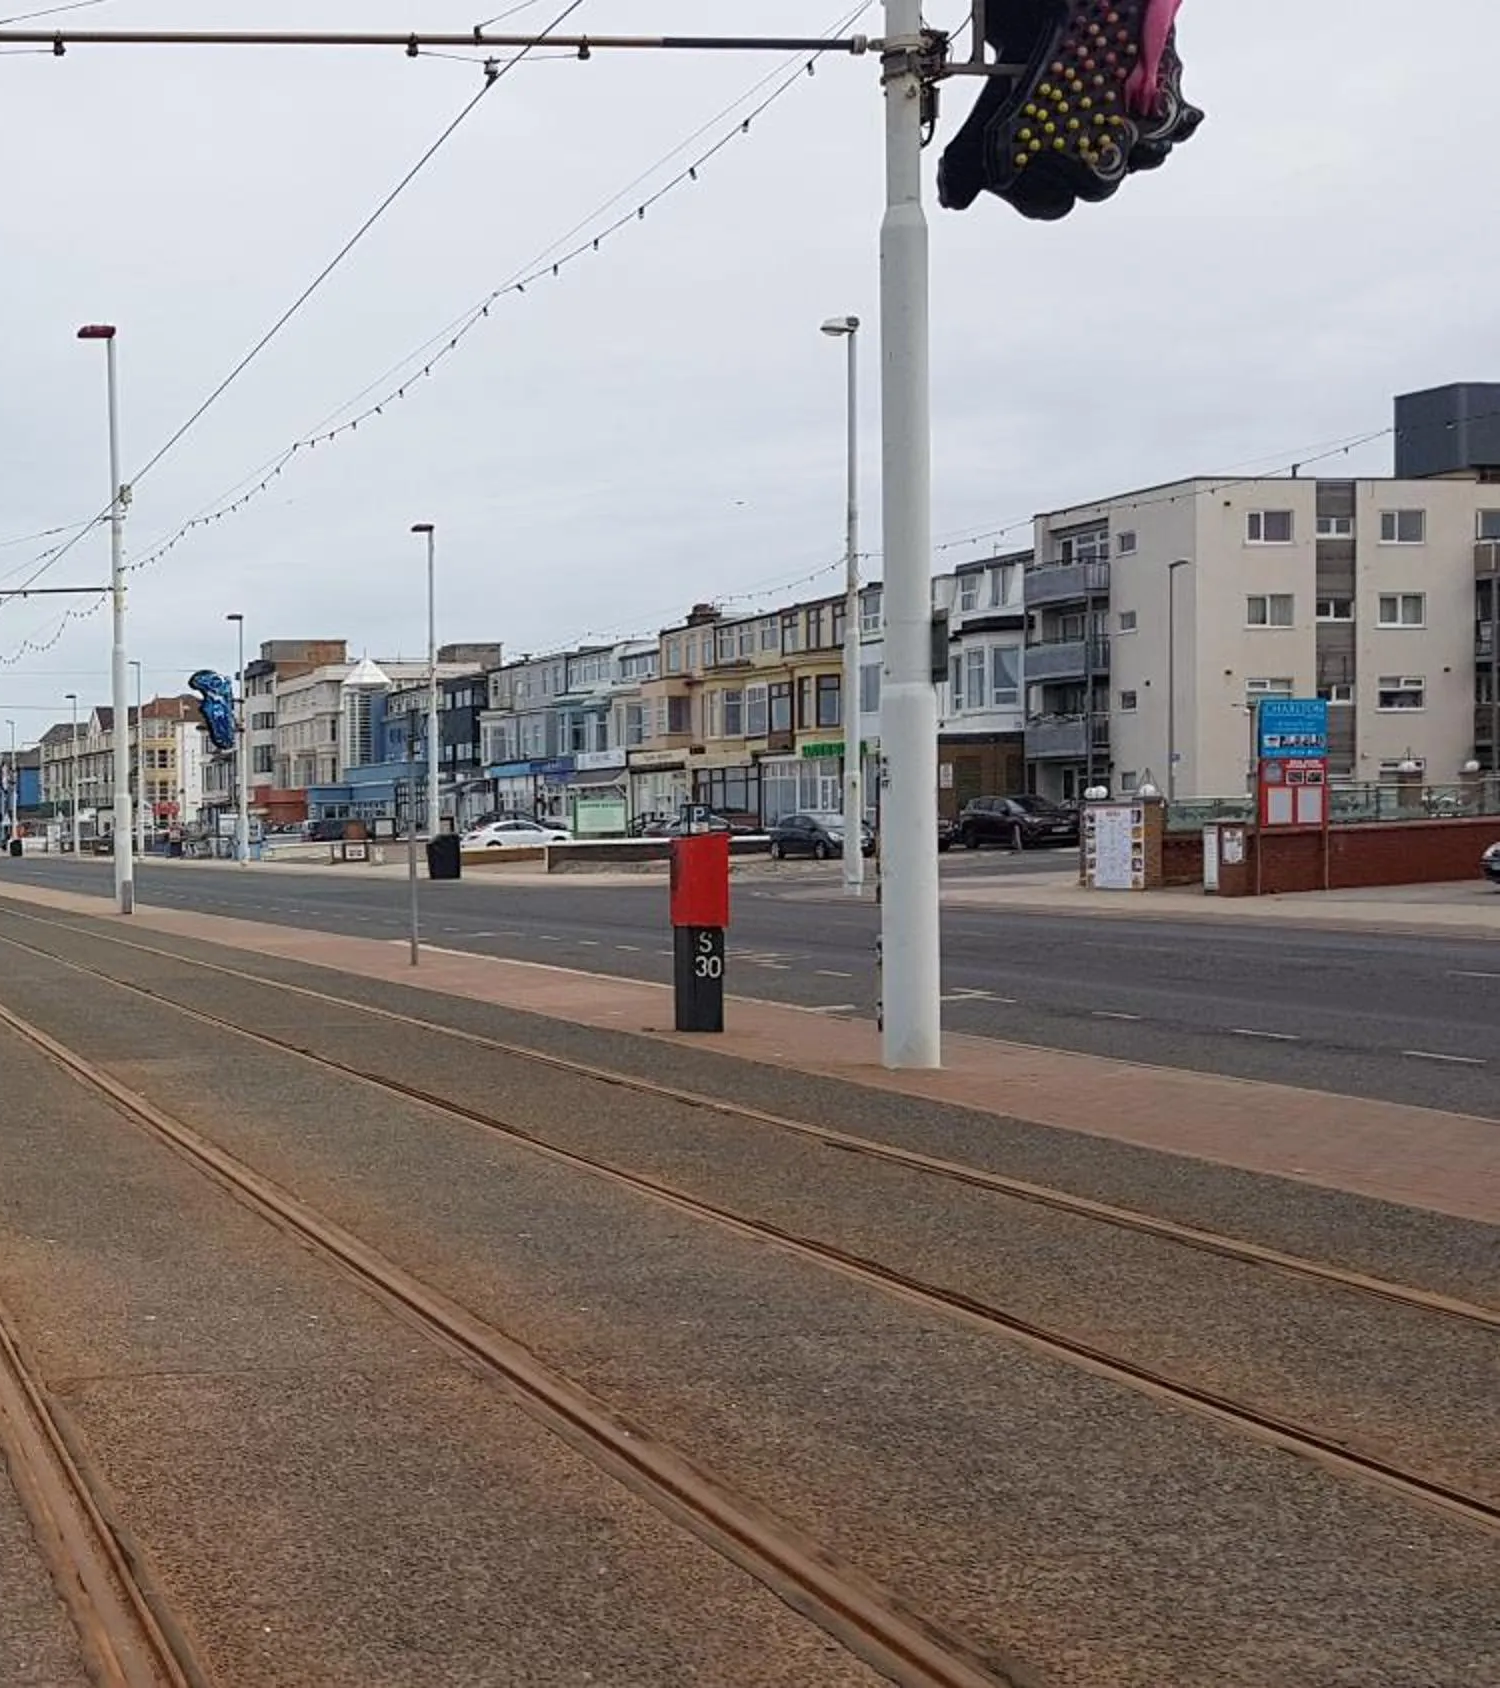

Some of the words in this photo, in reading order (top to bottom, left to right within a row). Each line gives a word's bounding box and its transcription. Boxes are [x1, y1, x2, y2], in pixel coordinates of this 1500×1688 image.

[694, 807, 704, 822] P
[699, 931, 713, 953] S
[695, 955, 721, 978] 30
